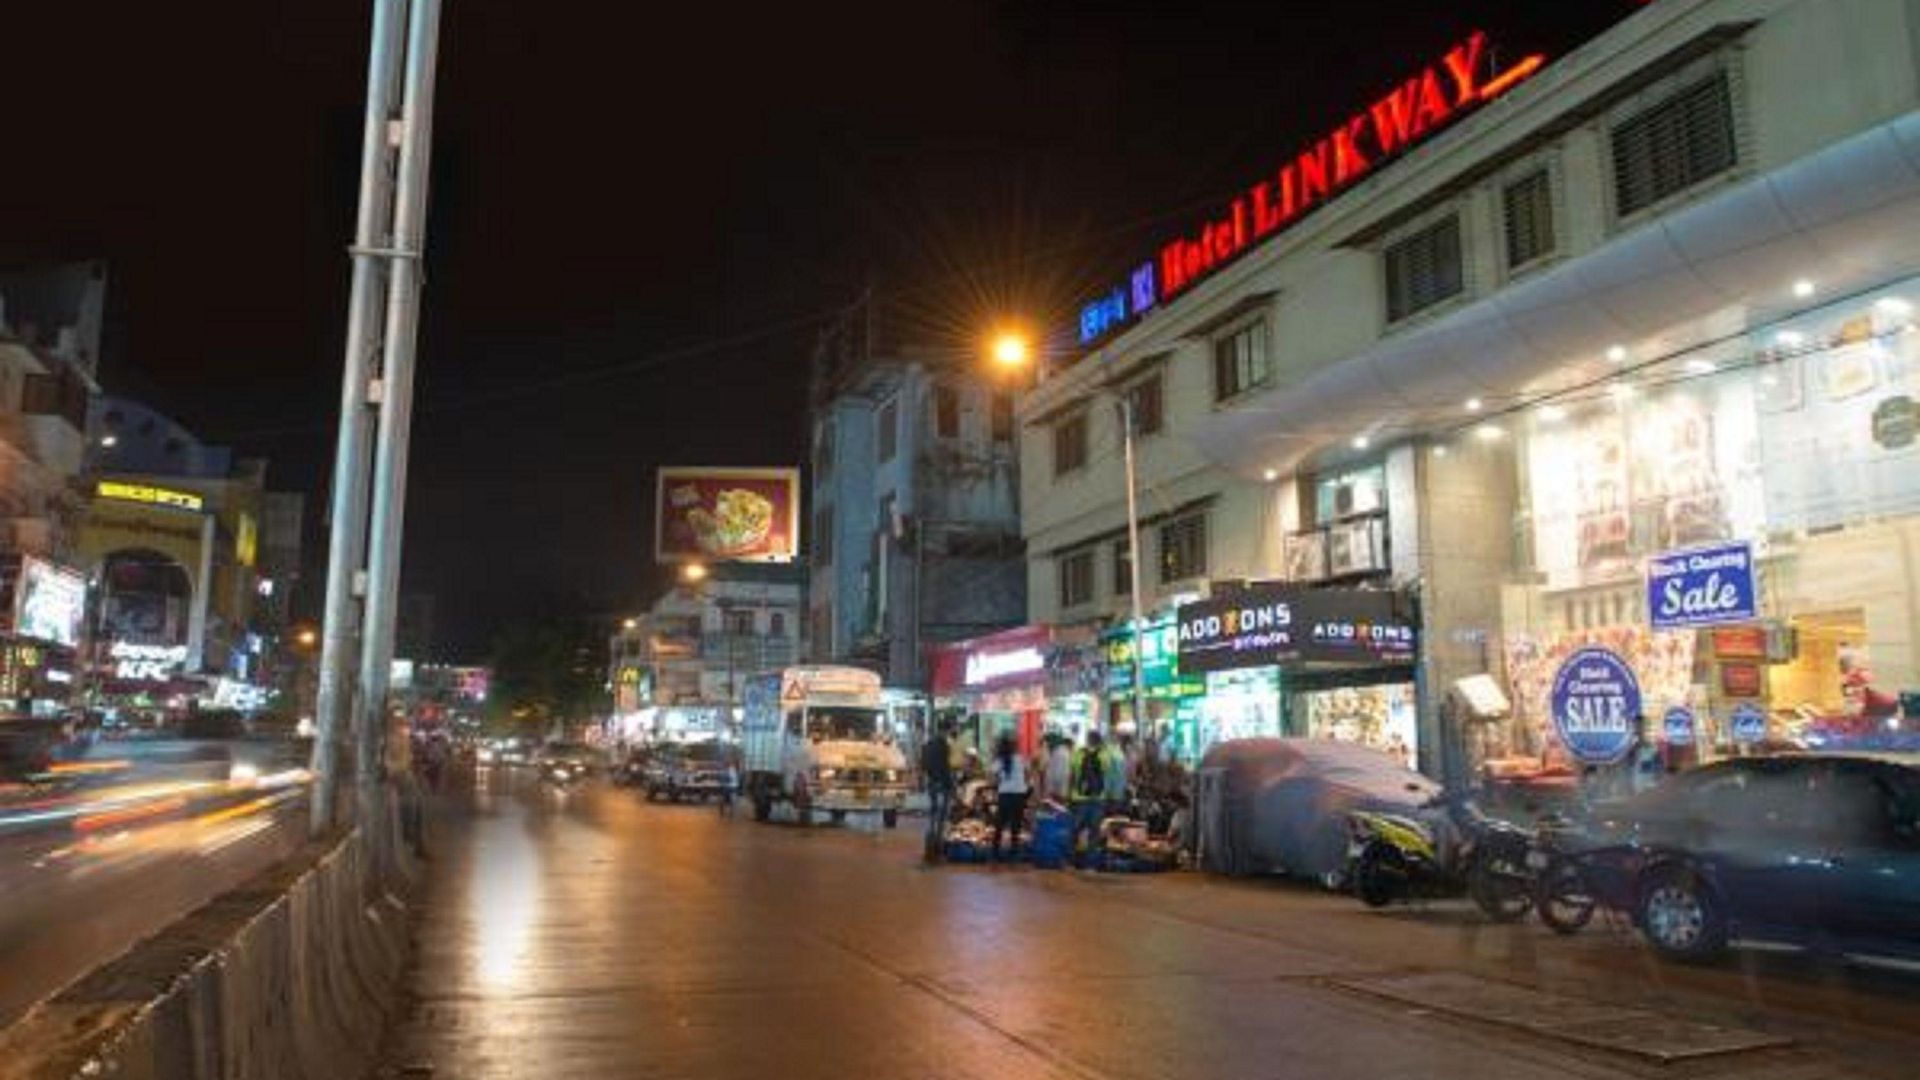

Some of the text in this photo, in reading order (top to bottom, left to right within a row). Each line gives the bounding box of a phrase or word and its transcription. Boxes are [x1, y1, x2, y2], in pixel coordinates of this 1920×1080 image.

[1161, 199, 1246, 300] Hotel
[1661, 571, 1738, 615] Sale
[1567, 695, 1626, 733] SALE
